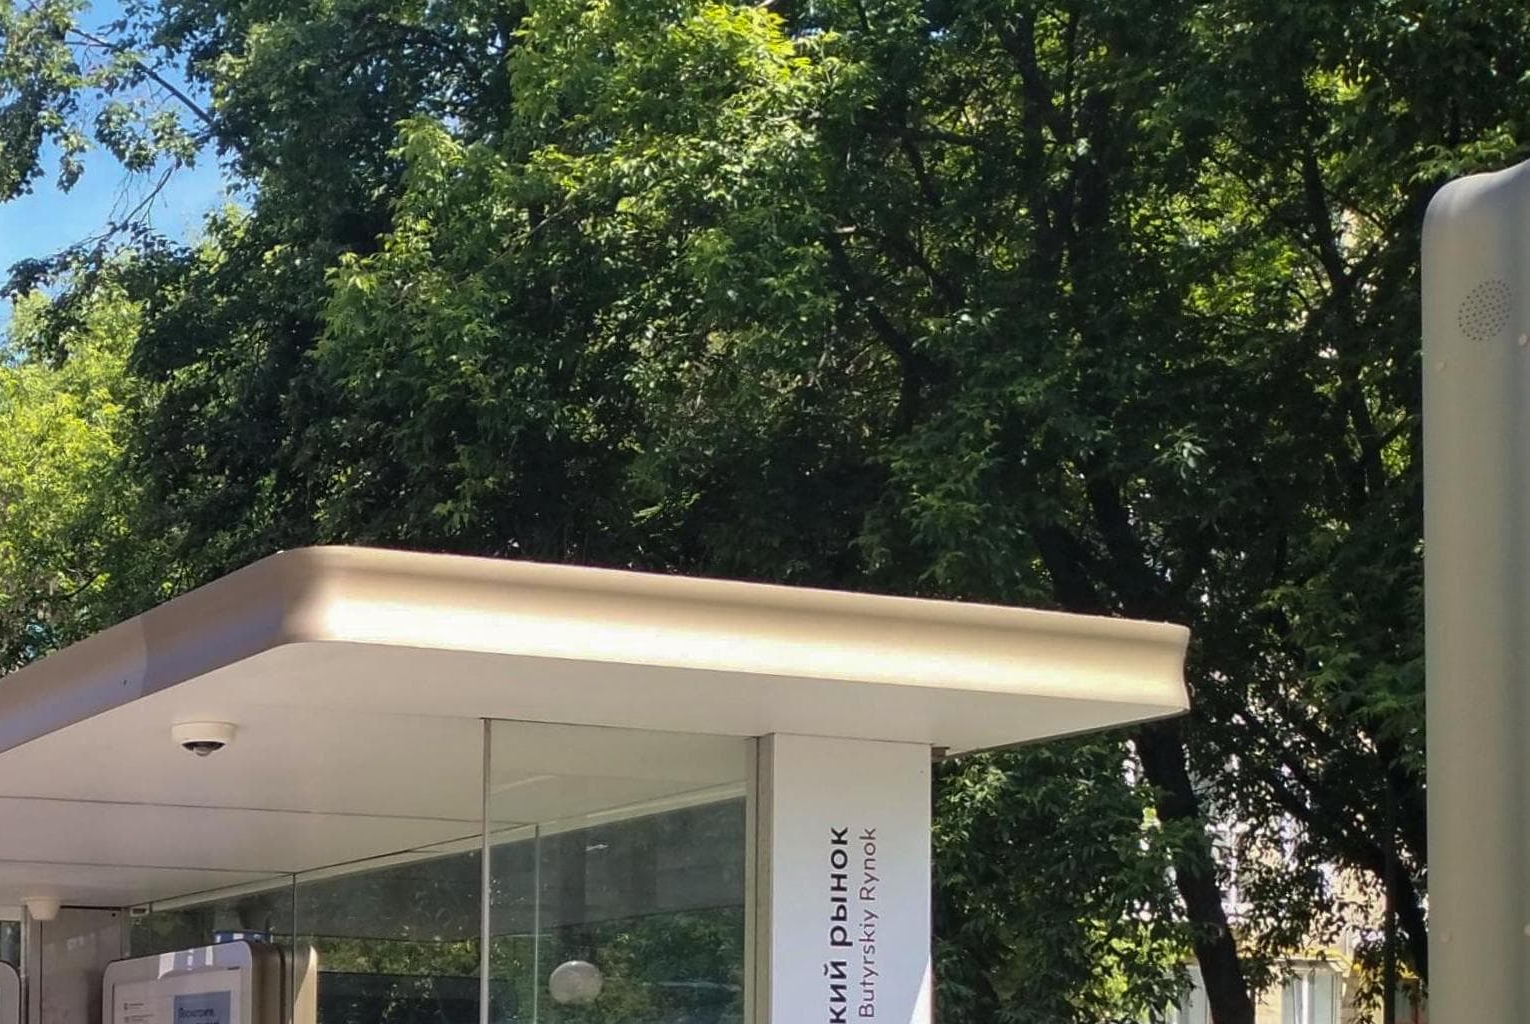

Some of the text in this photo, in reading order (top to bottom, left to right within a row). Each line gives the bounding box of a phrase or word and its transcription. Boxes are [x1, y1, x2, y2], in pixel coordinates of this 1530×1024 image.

[830, 827, 853, 947] рынок
[858, 828, 879, 1018] Butyrskiy Rynok
